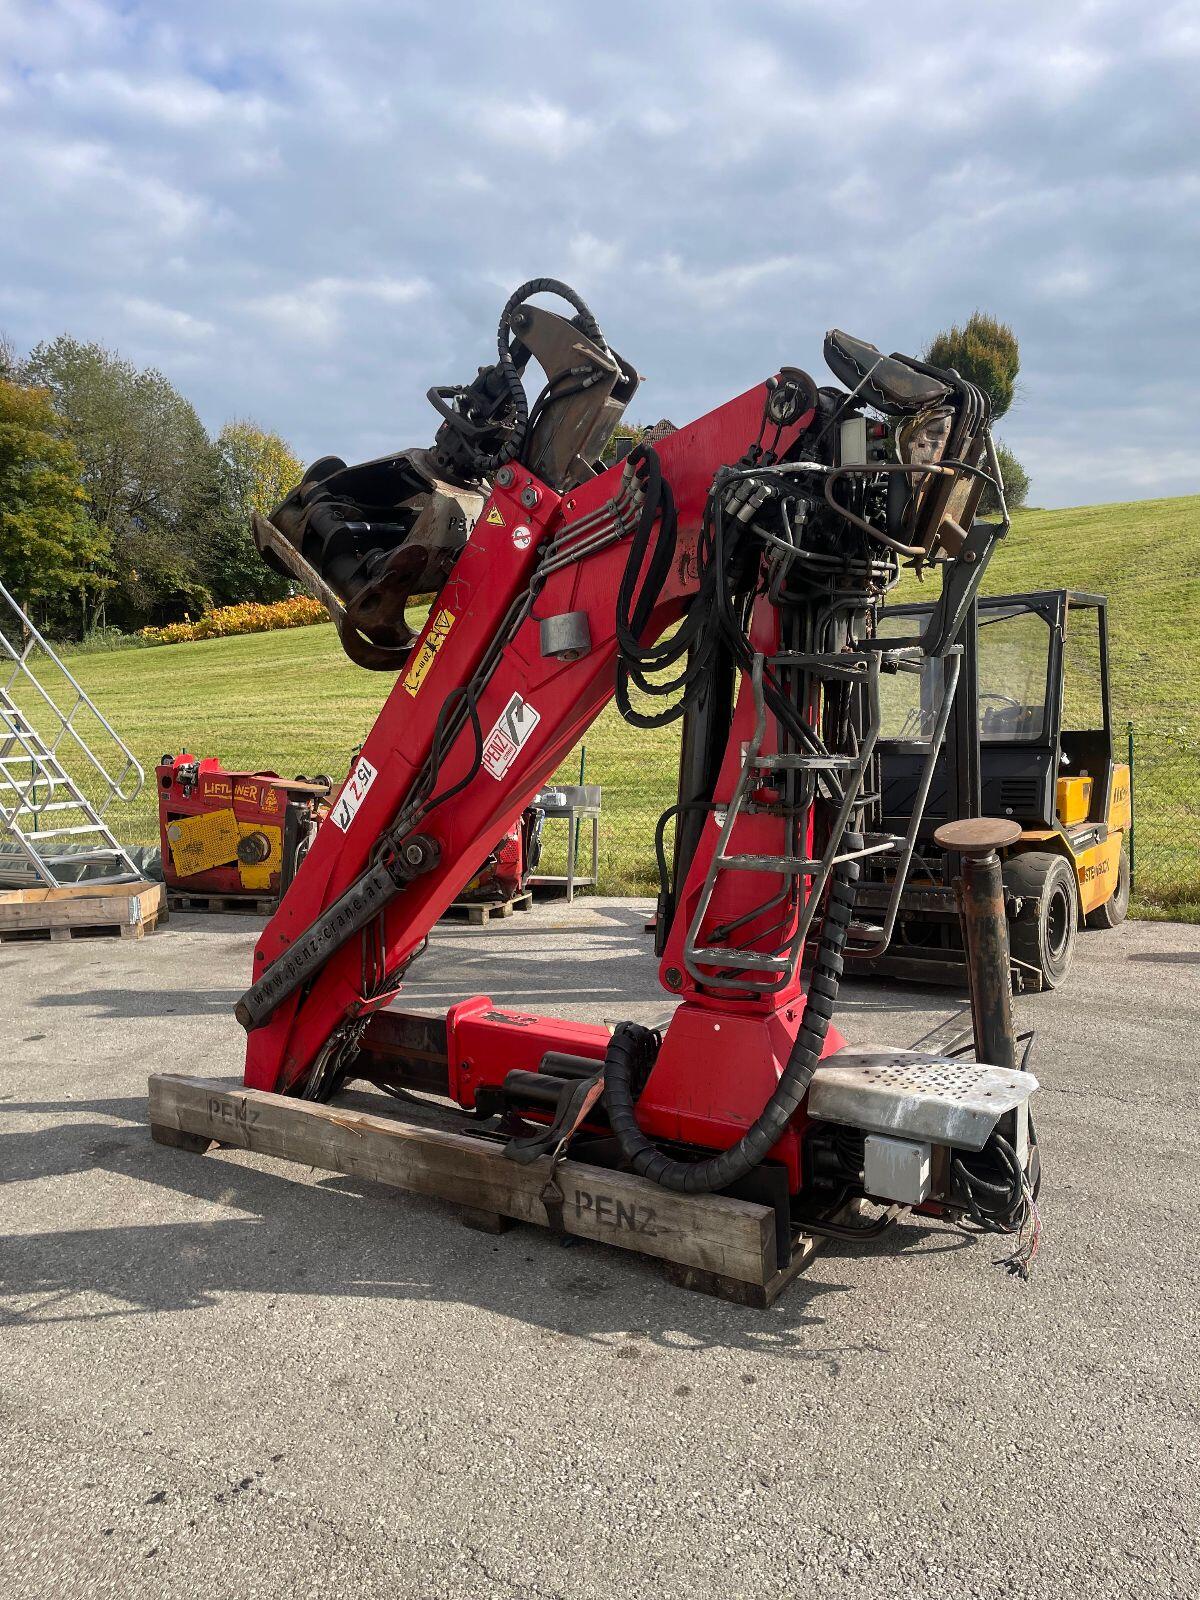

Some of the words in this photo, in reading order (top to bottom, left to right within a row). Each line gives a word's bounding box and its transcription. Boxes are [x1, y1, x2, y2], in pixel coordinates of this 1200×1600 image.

[482, 734, 509, 769] PENZ
[209, 1097, 260, 1132] PENZ
[575, 1189, 658, 1237] PENZ
